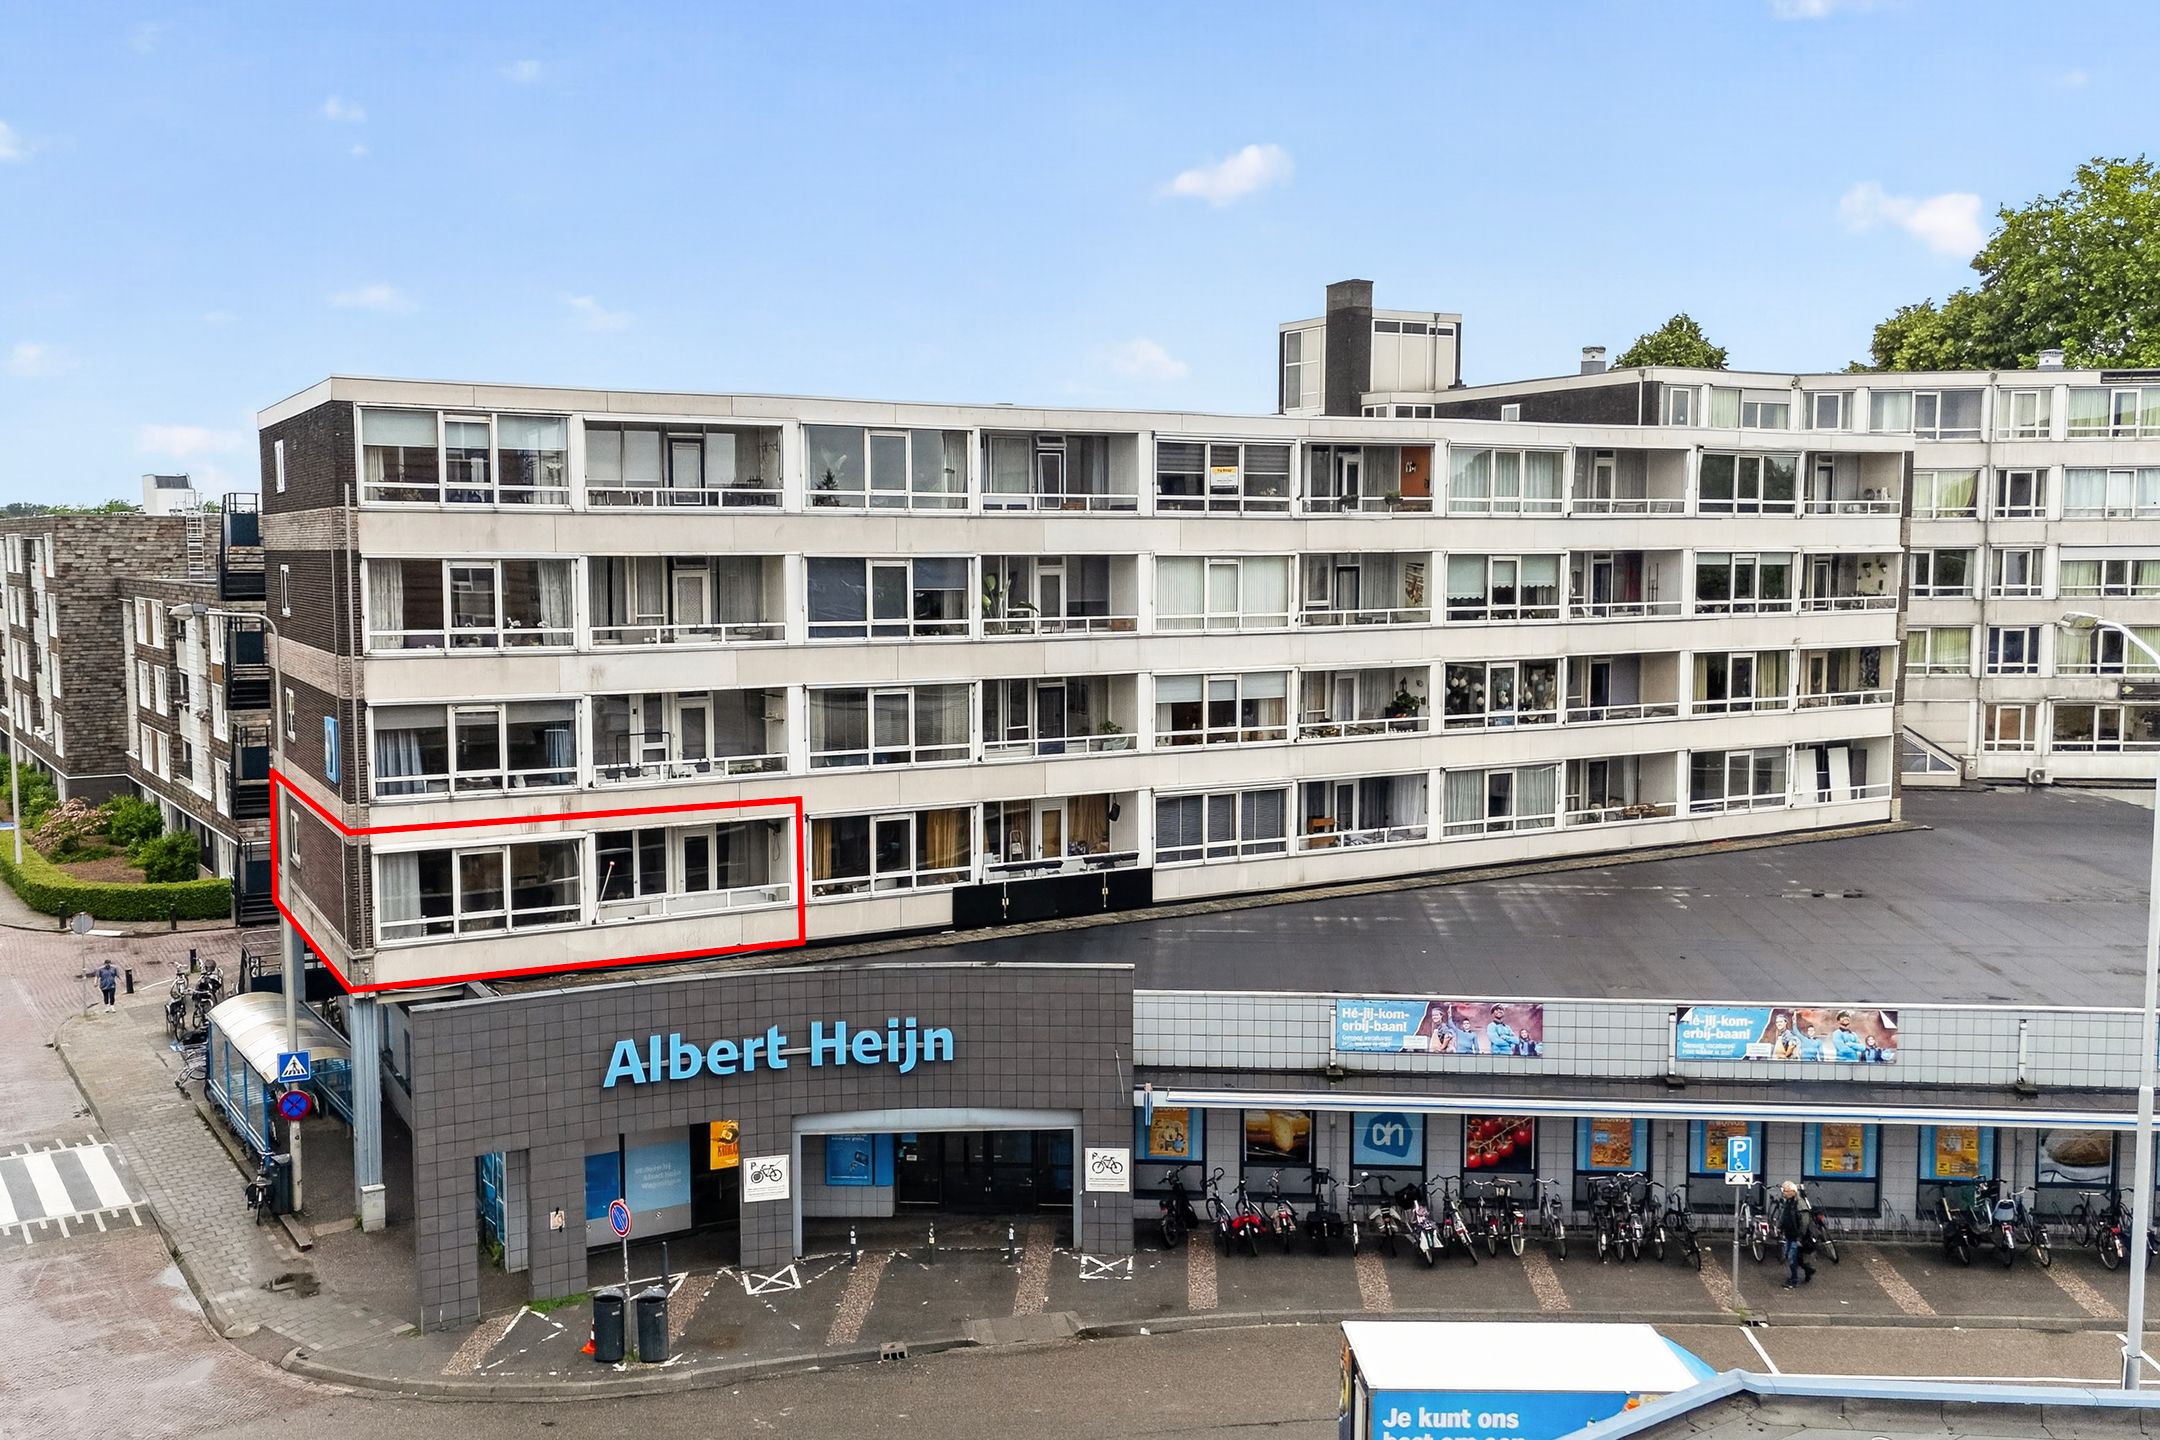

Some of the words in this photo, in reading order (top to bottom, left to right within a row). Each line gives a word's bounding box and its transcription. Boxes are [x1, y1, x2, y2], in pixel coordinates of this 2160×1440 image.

[1342, 1021, 1408, 1033] erbij-baan!
[1683, 1028, 1751, 1040] erbij-baan!
[603, 1024, 788, 1088] Albert
[810, 1016, 954, 1073] Heijn
[1733, 1140, 1747, 1158] P
[1383, 1408, 1411, 1428] Je
[1419, 1407, 1471, 1428] kunt
[1478, 1411, 1520, 1428] ons
